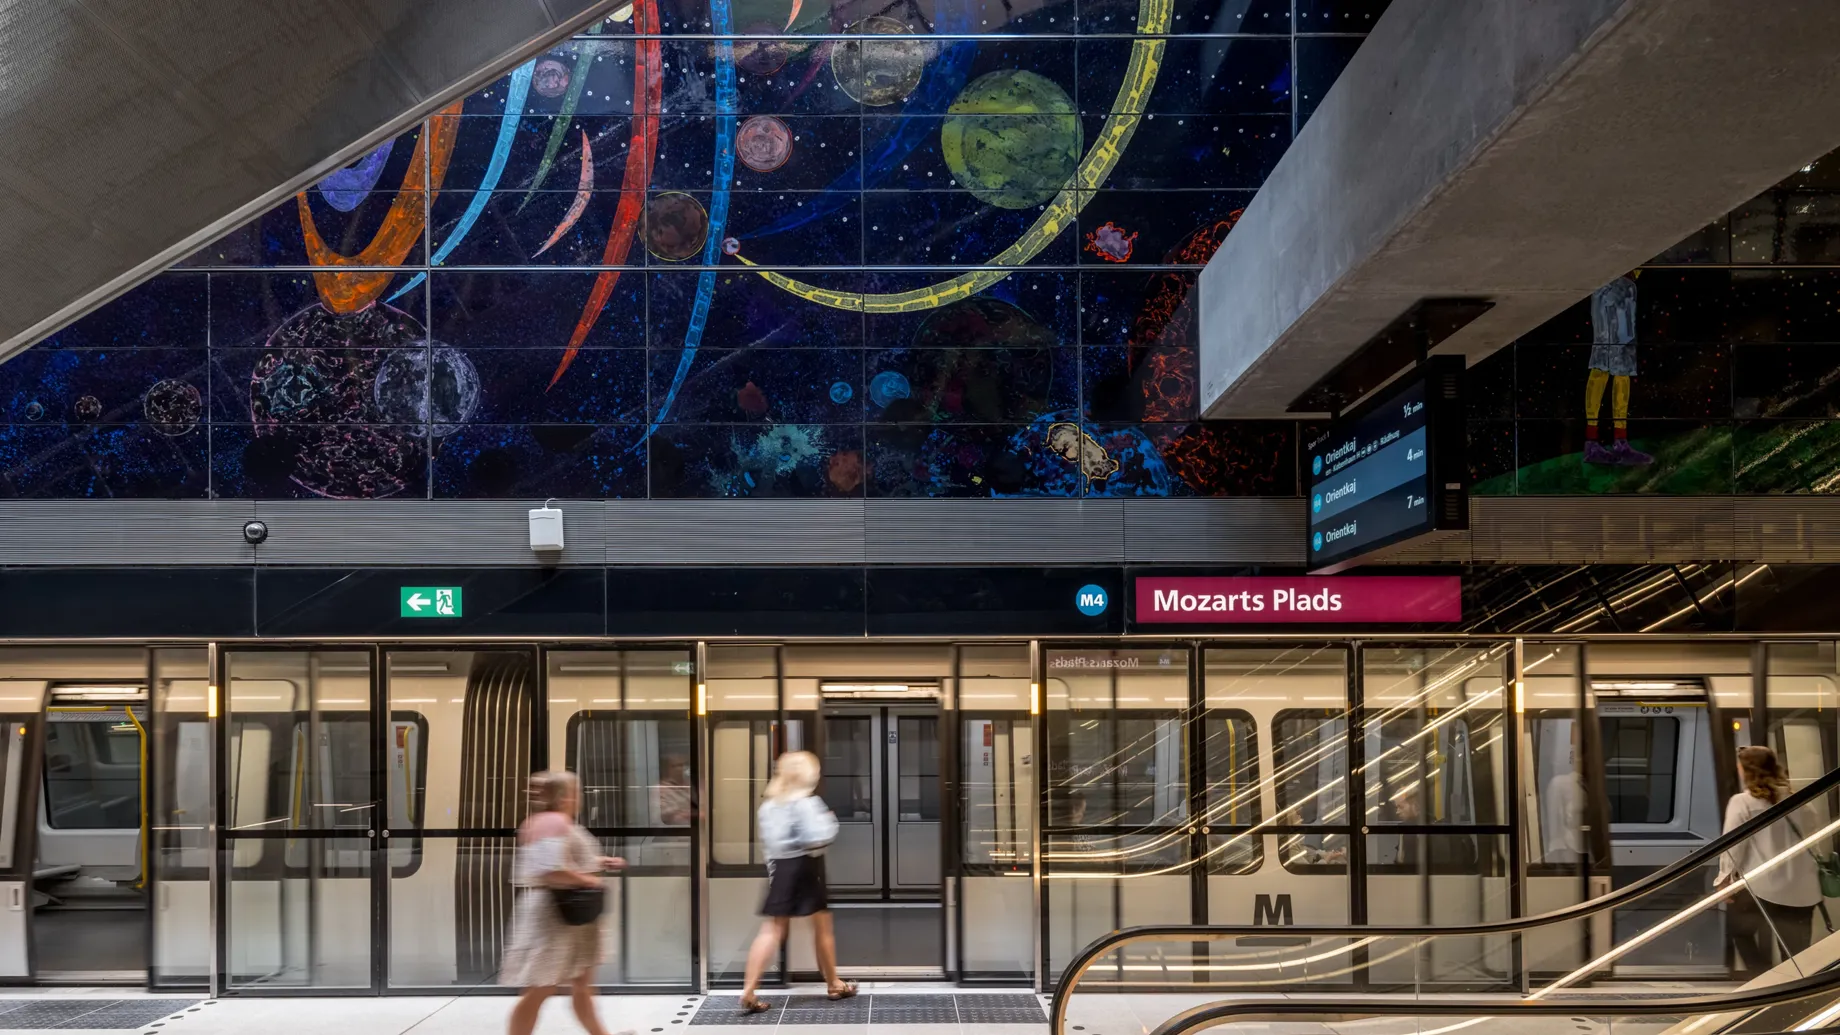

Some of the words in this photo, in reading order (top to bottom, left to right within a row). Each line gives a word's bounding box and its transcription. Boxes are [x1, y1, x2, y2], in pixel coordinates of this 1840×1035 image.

[1412, 402, 1423, 413] min
[1325, 436, 1356, 464] Orientkaj
[1406, 448, 1413, 462] 4
[1413, 449, 1424, 460] min
[1325, 478, 1356, 504] Orientkaj
[1407, 495, 1413, 509] 7
[1413, 496, 1425, 507] min
[1325, 520, 1356, 542] Orientkaj
[1080, 593, 1104, 607] M4
[1153, 589, 1265, 612] Mozarts
[1273, 588, 1342, 611] Plads
[1253, 893, 1294, 926] M
